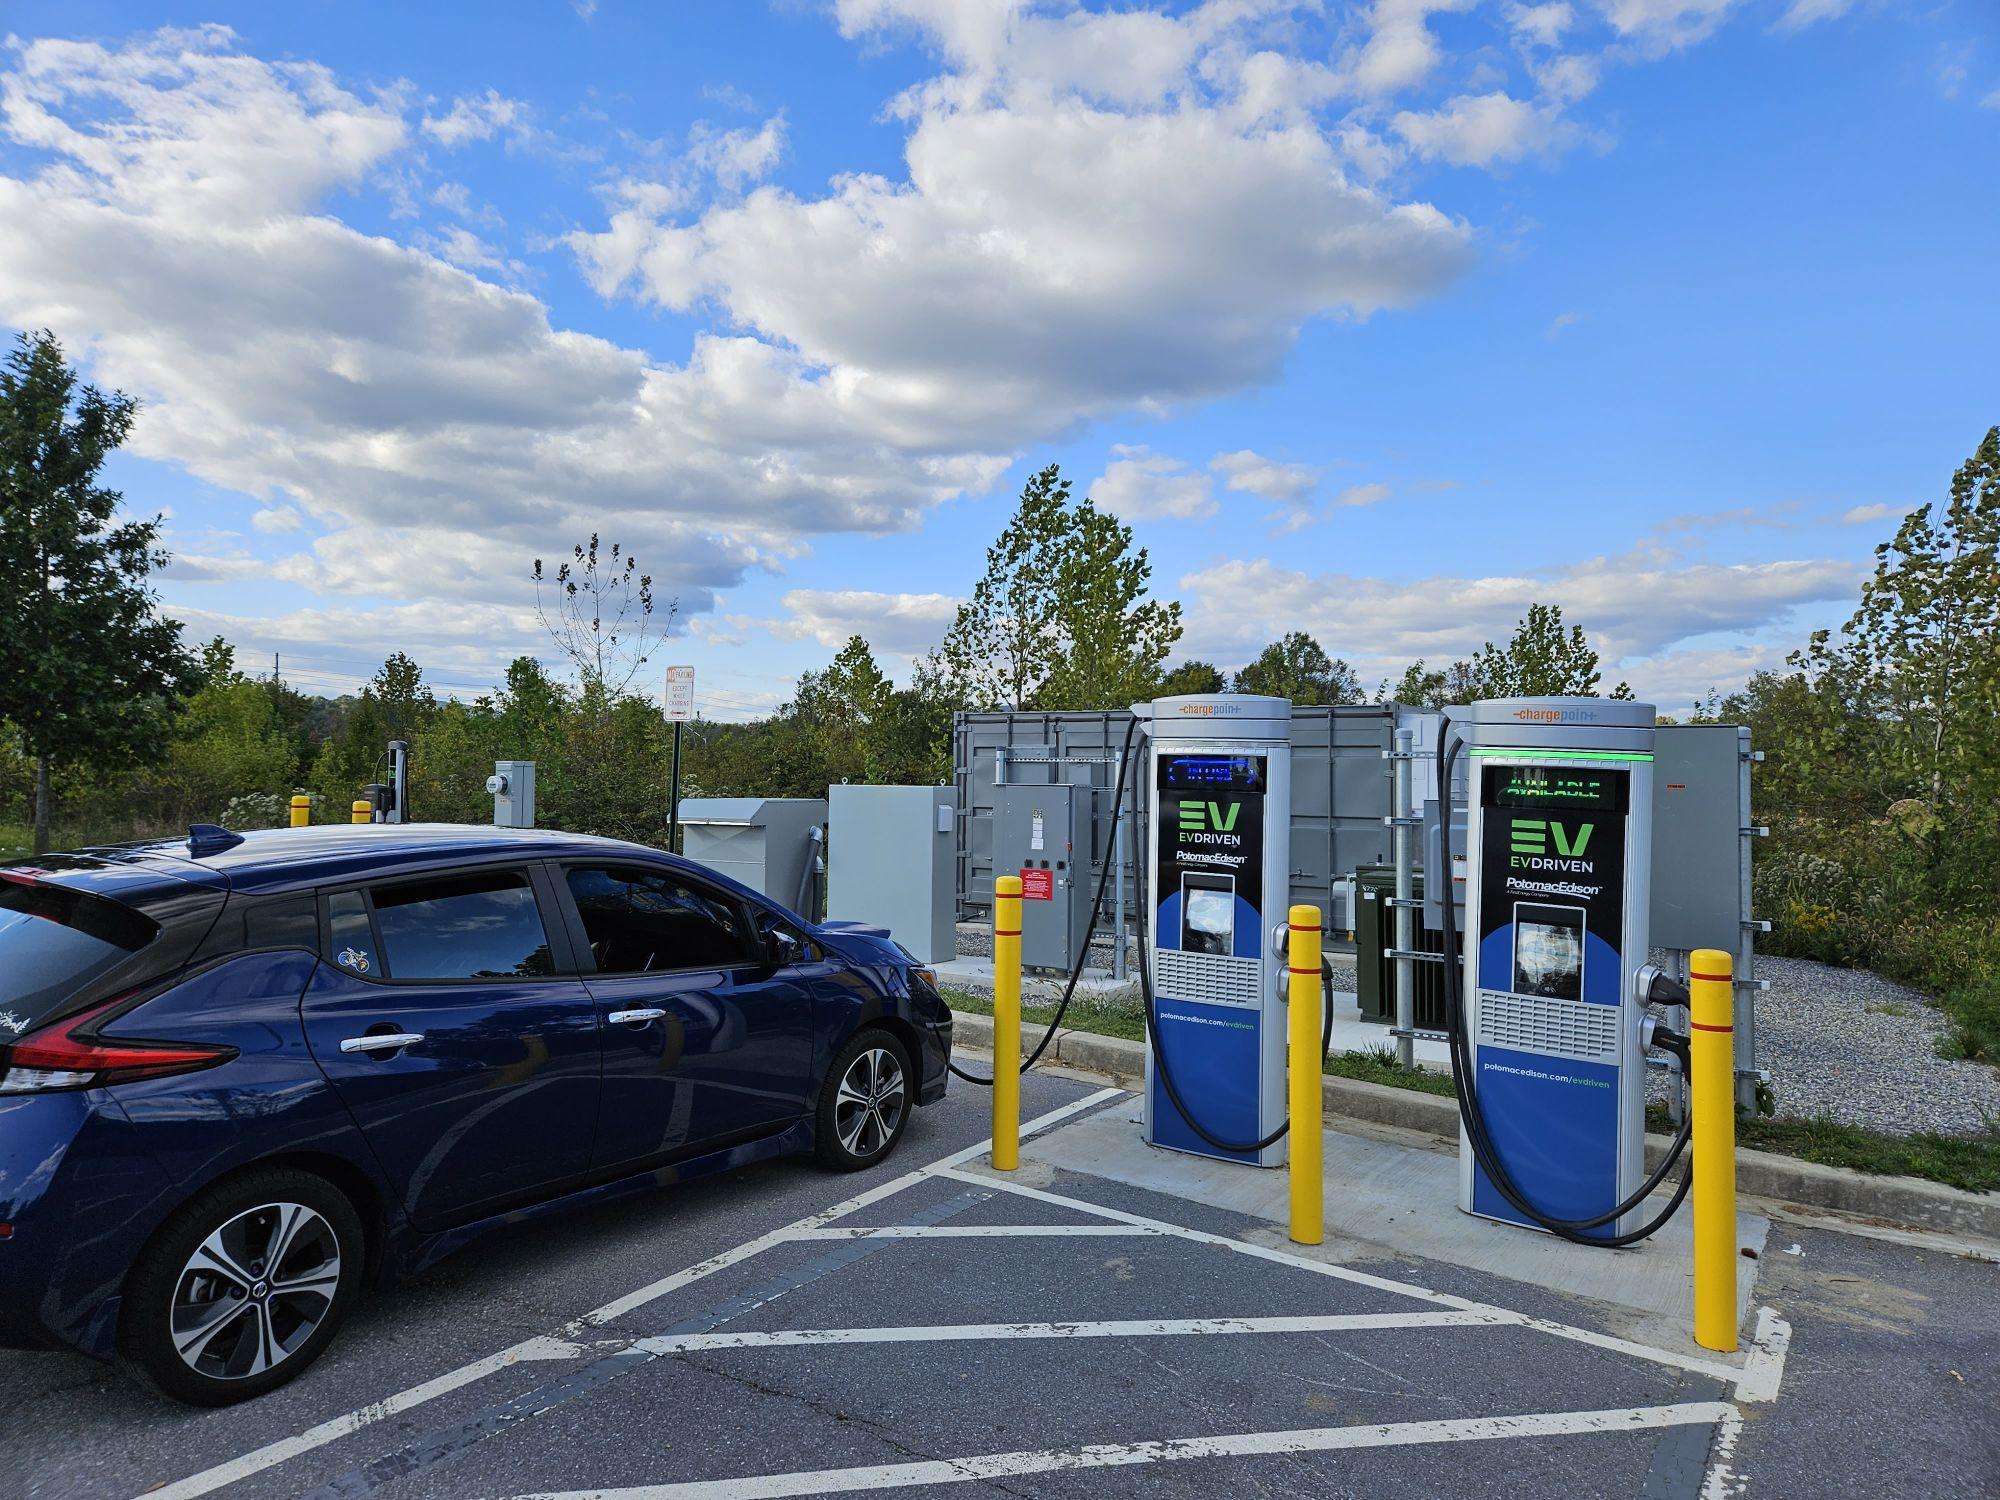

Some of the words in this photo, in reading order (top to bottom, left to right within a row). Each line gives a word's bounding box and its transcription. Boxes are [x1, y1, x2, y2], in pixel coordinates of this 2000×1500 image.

[1179, 703, 1241, 716] chargepoint
[1513, 708, 1597, 723] chargepoint
[1179, 801, 1241, 831] EV
[1179, 832, 1241, 846] EVDRIVEN
[1511, 819, 1594, 857] EV
[1176, 850, 1245, 865] PotomacEdison
[1510, 856, 1594, 874] EVDRIVEN
[1506, 877, 1599, 895] PotomacEdison
[1160, 1011, 1255, 1031] potomacedison.com/evdriven
[1484, 1062, 1610, 1089] potomacedison.com/evdriven
